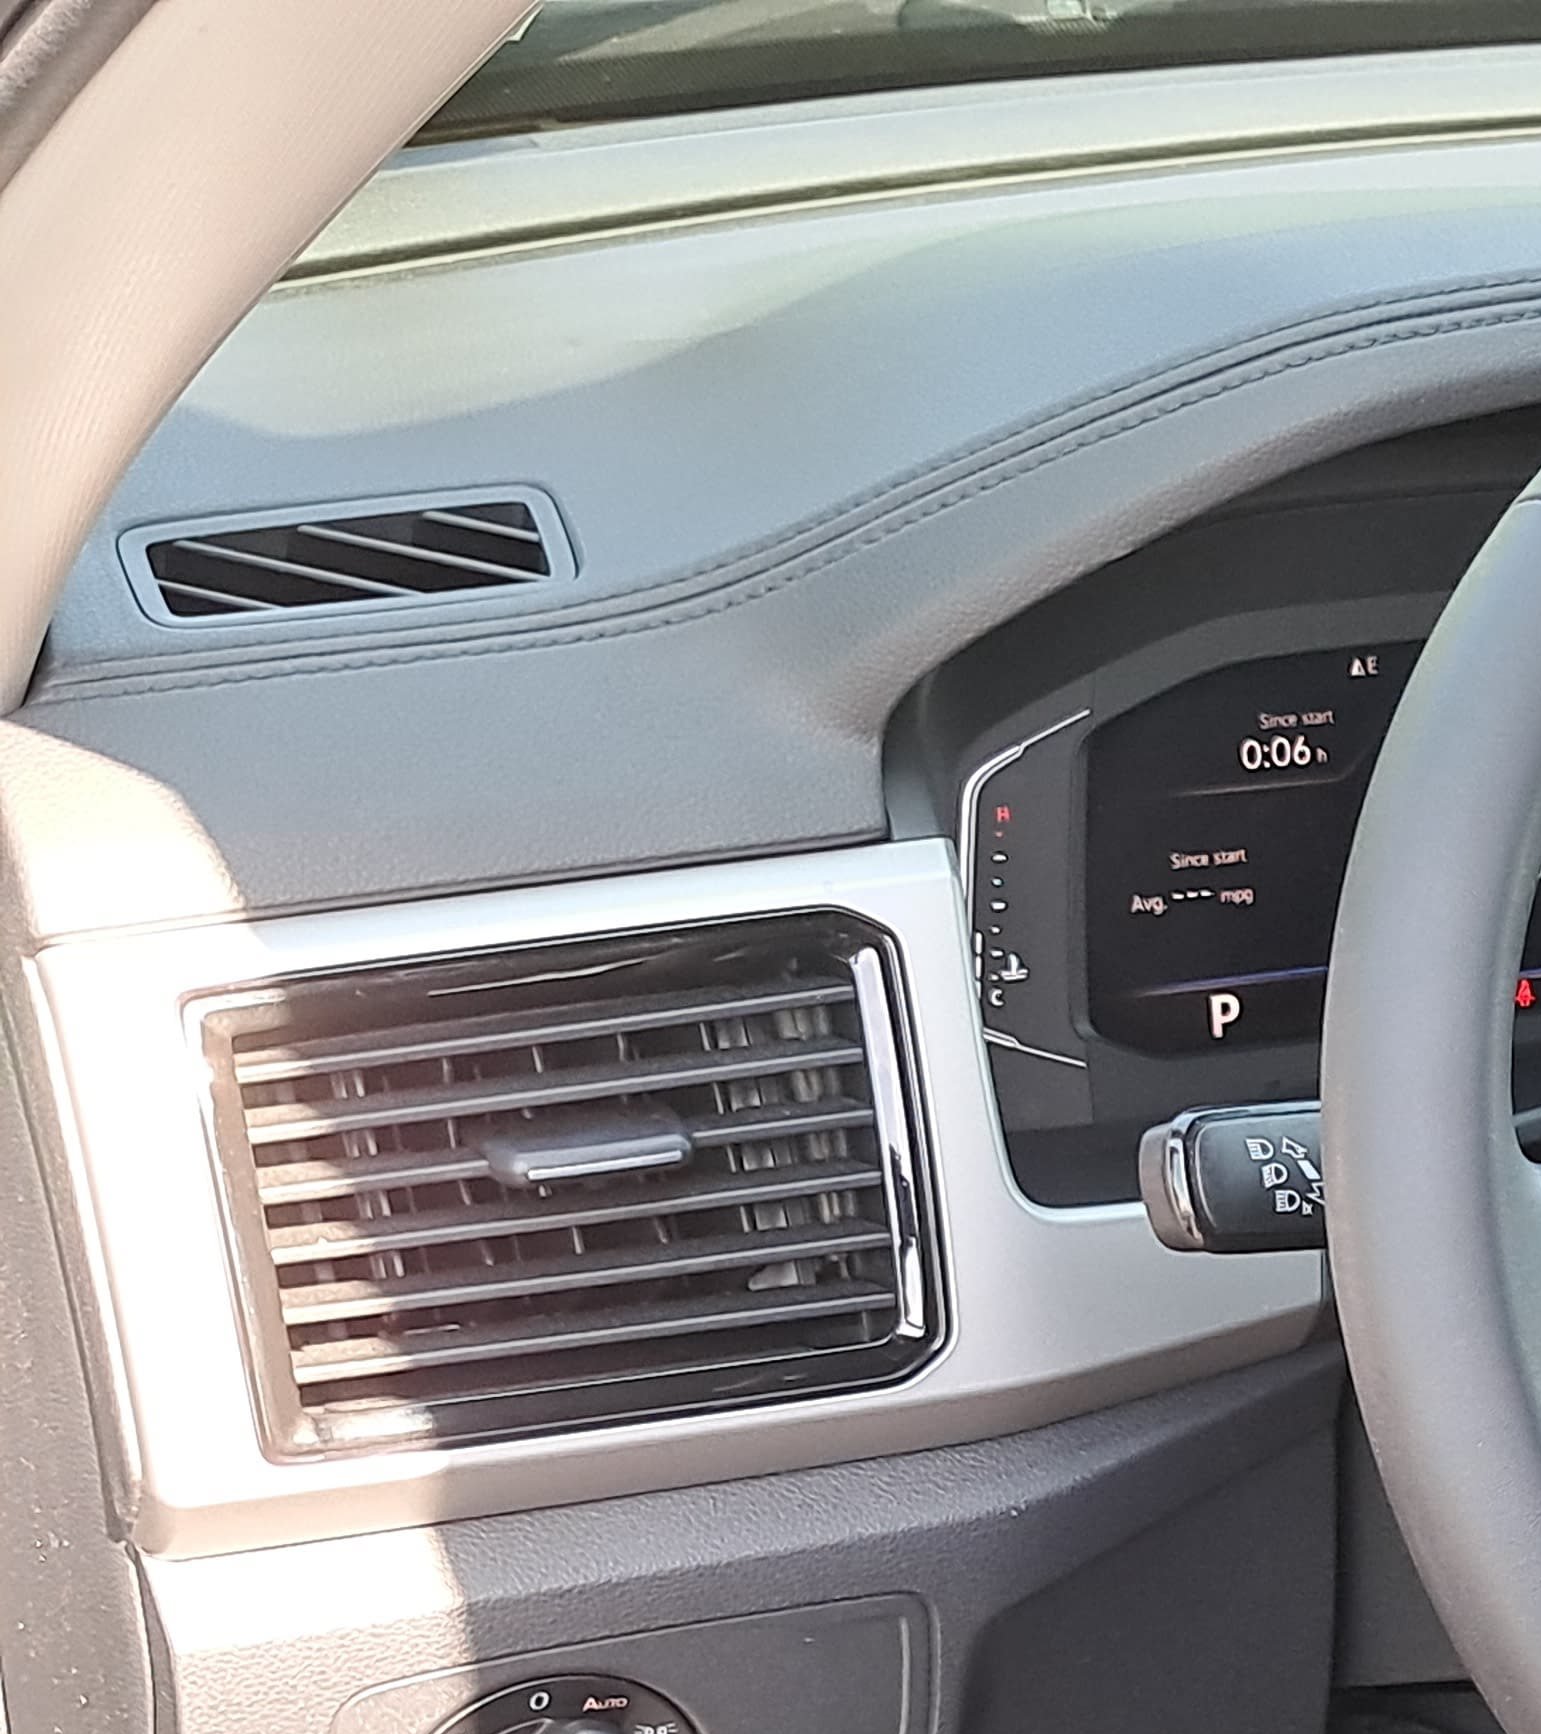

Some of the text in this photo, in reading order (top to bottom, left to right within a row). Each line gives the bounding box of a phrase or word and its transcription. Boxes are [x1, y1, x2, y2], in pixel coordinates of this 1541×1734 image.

[1259, 709, 1336, 730] Since start
[1239, 735, 1311, 771] 0:06
[1170, 848, 1248, 870] Since start
[1131, 893, 1167, 914] Avg.
[1220, 887, 1254, 906] mpg
[1209, 994, 1240, 1038] P
